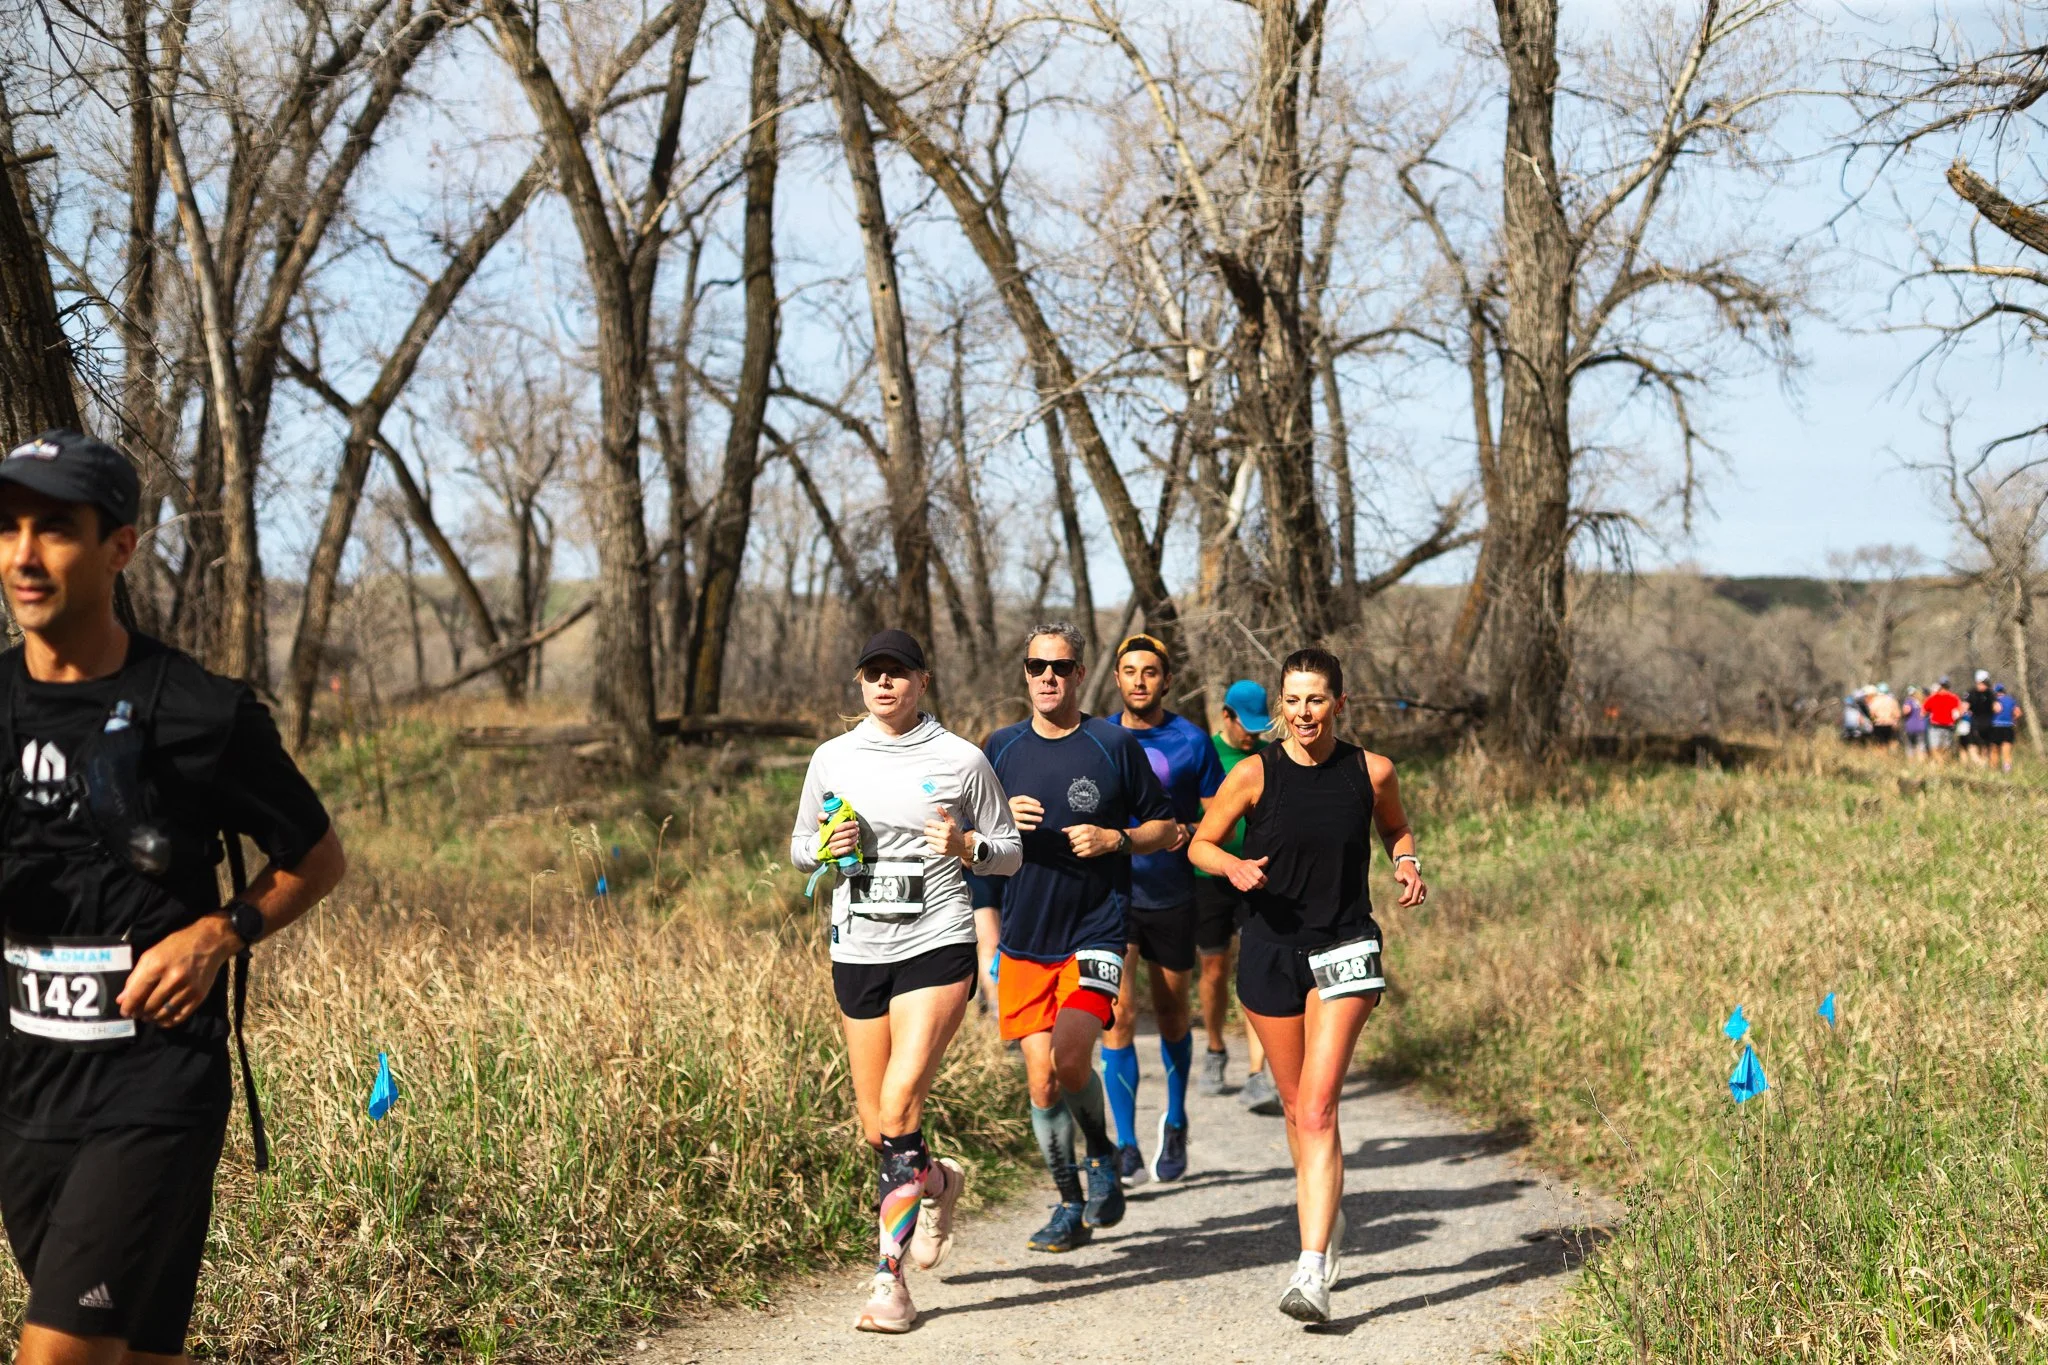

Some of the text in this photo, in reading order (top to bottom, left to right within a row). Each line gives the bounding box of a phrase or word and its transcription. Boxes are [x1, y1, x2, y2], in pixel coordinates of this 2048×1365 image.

[869, 878, 899, 900] 53
[1098, 961, 1119, 985] 88
[1336, 957, 1367, 982] 28
[22, 971, 100, 1017] 142
